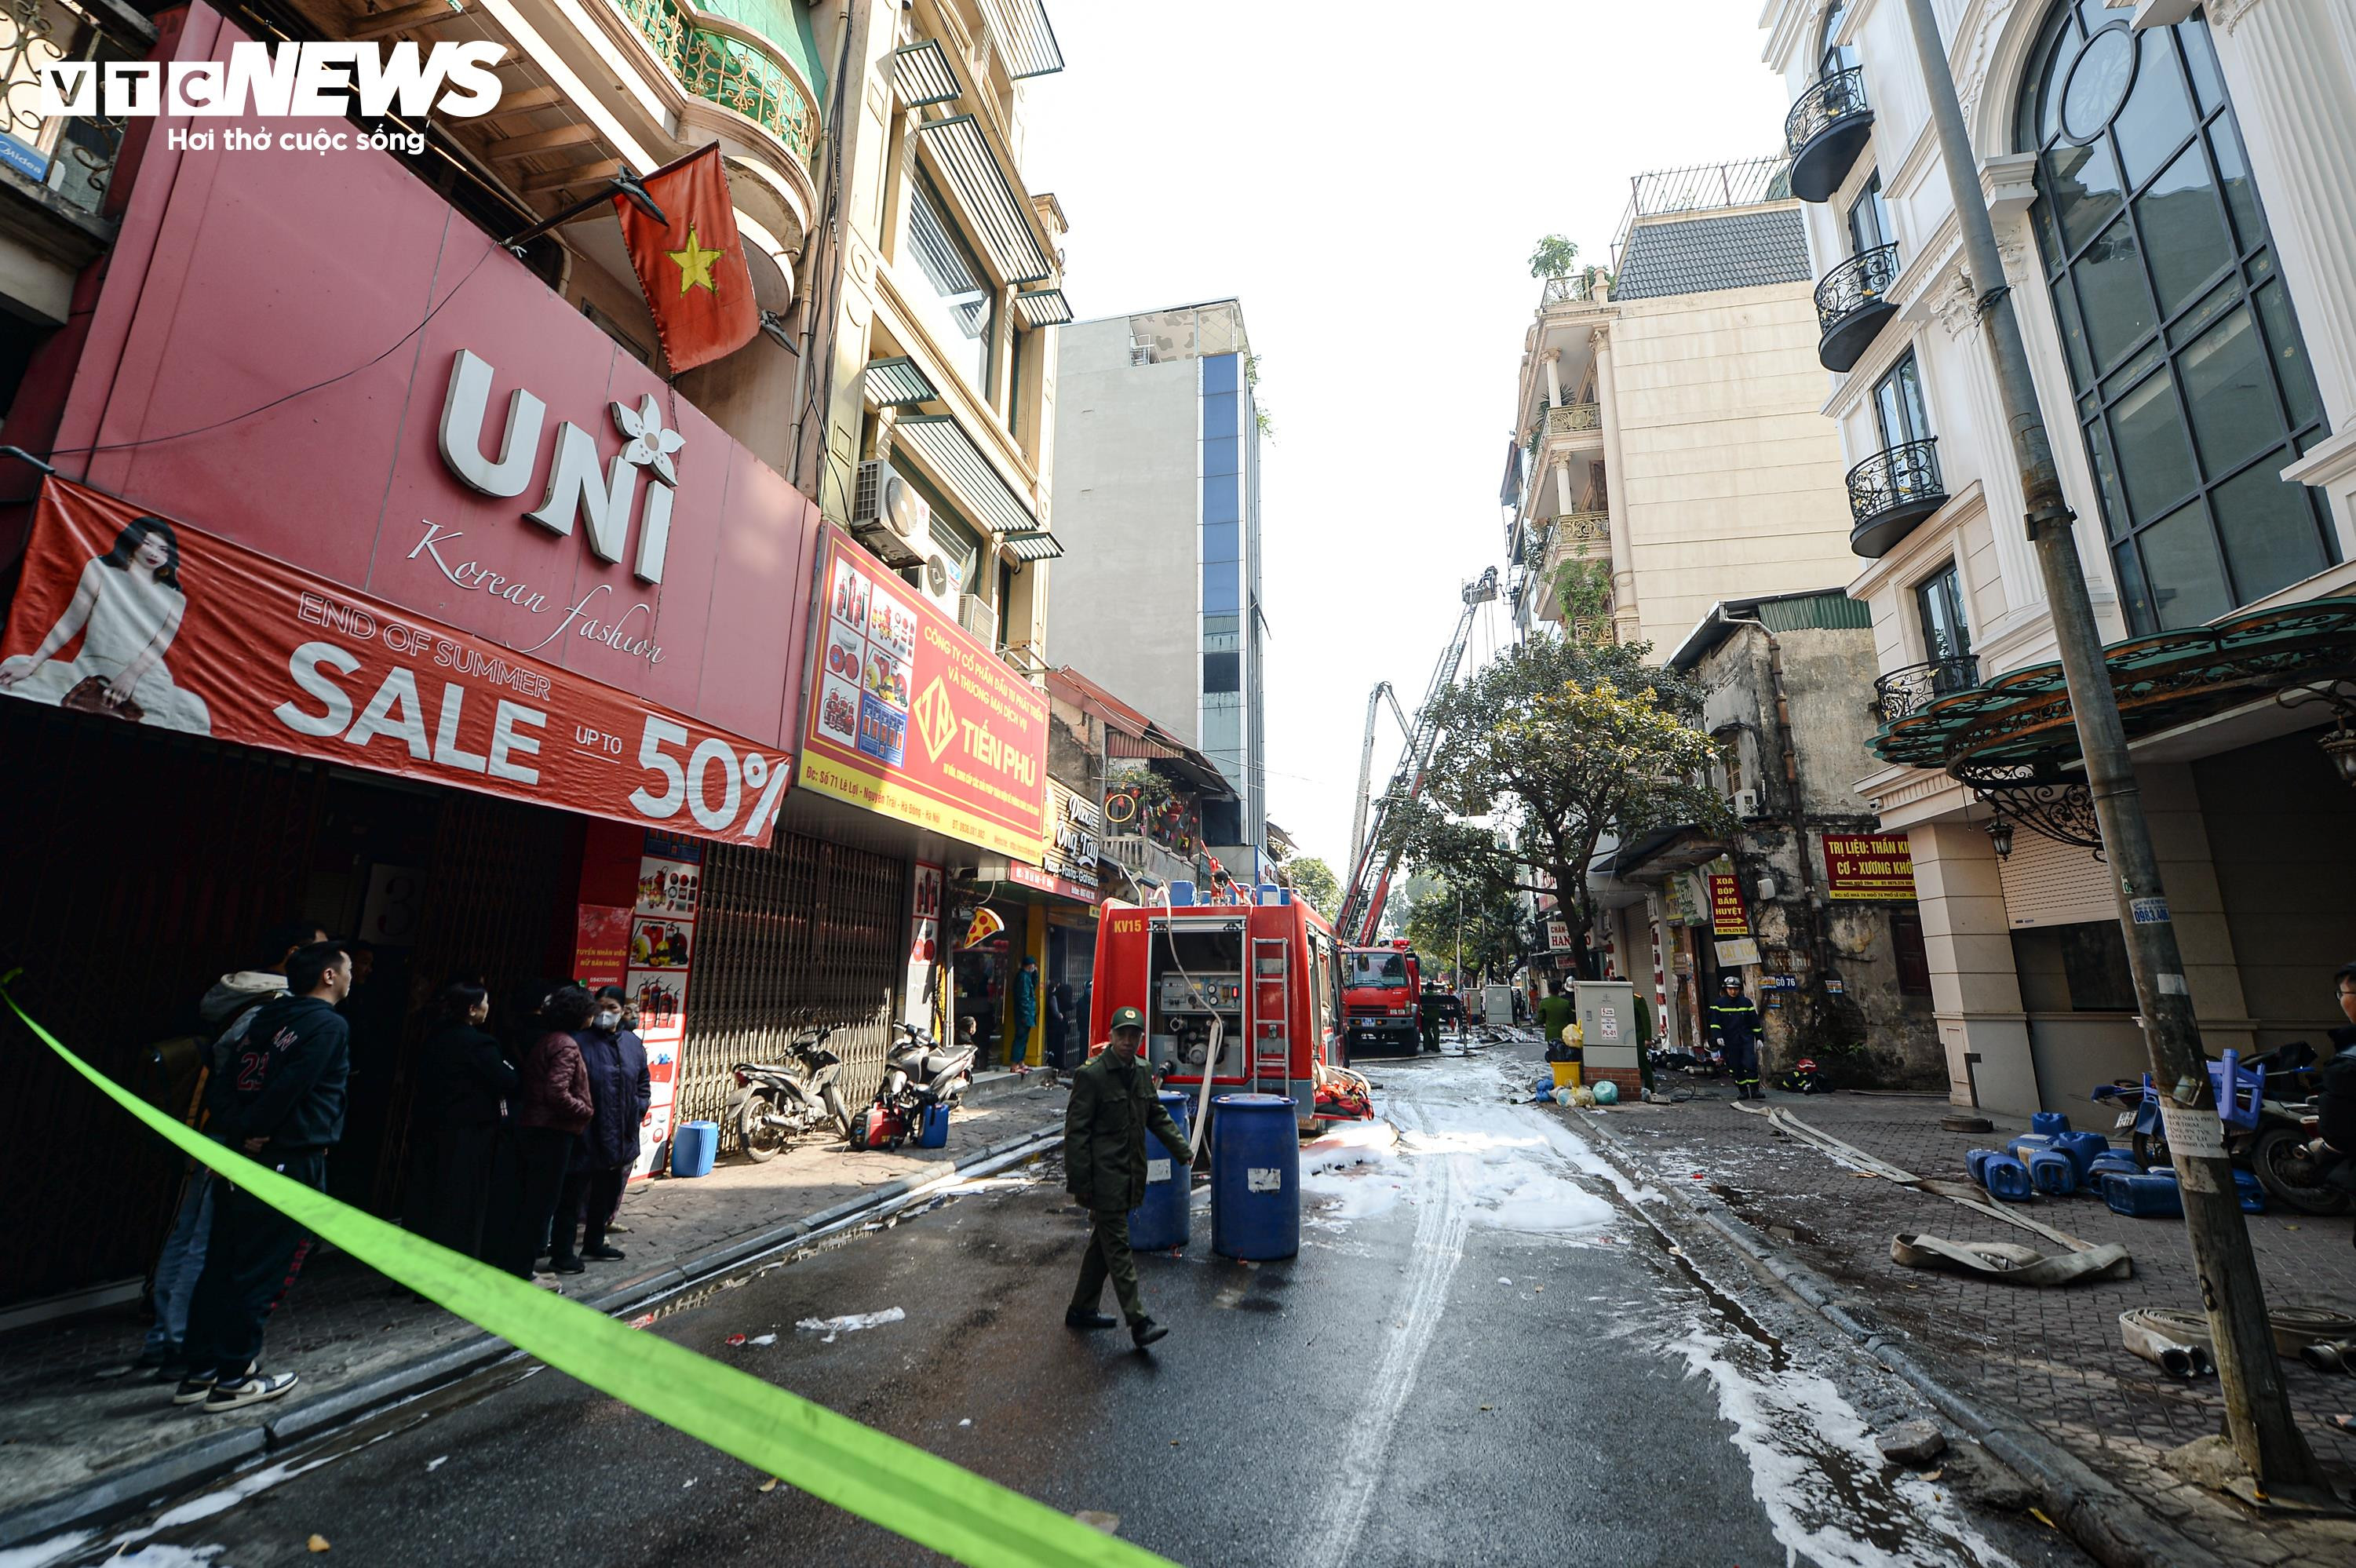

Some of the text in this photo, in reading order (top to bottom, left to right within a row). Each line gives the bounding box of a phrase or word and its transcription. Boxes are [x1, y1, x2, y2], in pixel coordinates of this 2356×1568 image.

[407, 518, 667, 665] Korean fashion
[297, 590, 552, 702] END OF SUMMER
[924, 625, 951, 655] CÔNG
[952, 644, 962, 662] TY
[961, 653, 975, 672] CỔ
[947, 665, 960, 685] VÀ
[960, 673, 990, 705] THƯƠNG
[990, 696, 1004, 716] MẠI
[1003, 706, 1019, 724] DỊCH
[272, 640, 547, 786] SALE
[575, 725, 600, 746] UP
[601, 732, 622, 755] TO
[628, 714, 790, 837] 50%
[961, 717, 1002, 771] TIẾN
[1003, 743, 1036, 788] PHÚ
[819, 770, 830, 785] Số
[830, 775, 838, 789] 71
[840, 778, 848, 792] Lê
[848, 781, 859, 797] Lợi
[1056, 813, 1078, 857] Ông
[1079, 832, 1100, 868] Tây
[1828, 841, 1844, 857] TRỊ
[1845, 838, 1869, 857] LIỆU:
[1870, 837, 1896, 855] THẦN
[1836, 860, 1851, 875] CƠ
[1858, 860, 1891, 875] XƯƠNG
[1892, 859, 1913, 875] KHỚ
[1715, 906, 1742, 917] HUYỆT
[1717, 895, 1738, 905] BẤM
[1114, 920, 1142, 934] KV15
[596, 947, 613, 956] NHÂN
[1785, 978, 1796, 987] 76
